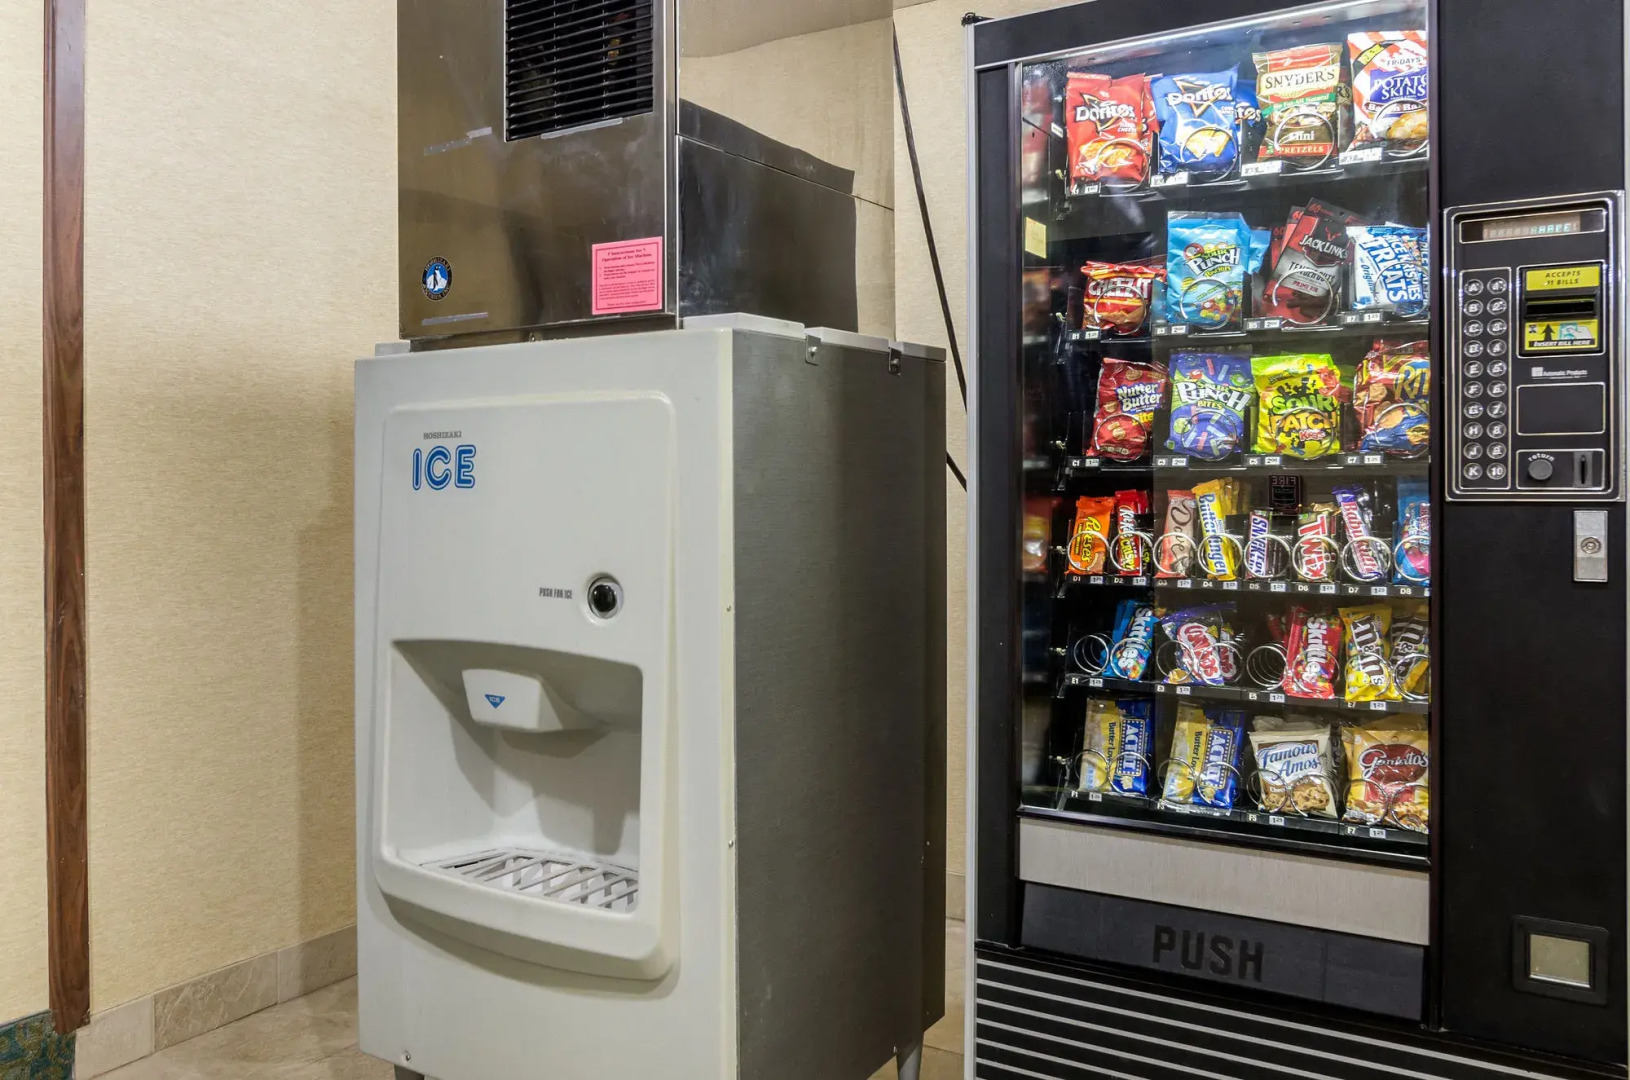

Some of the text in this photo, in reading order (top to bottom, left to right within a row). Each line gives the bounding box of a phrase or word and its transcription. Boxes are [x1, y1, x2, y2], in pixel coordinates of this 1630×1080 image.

[1265, 69, 1335, 89] SNYDER'S
[1167, 86, 1232, 105] Doritos
[1381, 84, 1426, 100] SKINS
[1075, 102, 1135, 121] Doritos
[1279, 146, 1324, 154] PRETZELS
[1187, 247, 1241, 276] PUNCH
[1359, 237, 1408, 303] TREATS
[1545, 270, 1581, 278] ACCEPTS
[1117, 383, 1159, 400] Nutter
[1394, 366, 1430, 399] RIT
[1121, 393, 1163, 412] Butter
[1176, 381, 1251, 411] PUNCH
[1198, 400, 1223, 409] BITES
[1271, 394, 1334, 415] SOUR
[1268, 411, 1337, 434] PATCH
[423, 431, 462, 440] HOSHIZAKI
[412, 444, 477, 491] ICE
[1528, 453, 1555, 462] return
[539, 587, 552, 598] PUSH
[564, 589, 573, 600] ICE
[1118, 607, 1153, 669] Skittles
[1302, 616, 1328, 683] Skittles
[1108, 721, 1117, 746] Butter
[1192, 731, 1203, 757] Butter
[1257, 743, 1318, 769] Famous
[1271, 757, 1319, 782] Amos
[1153, 924, 1265, 983] PUSH
